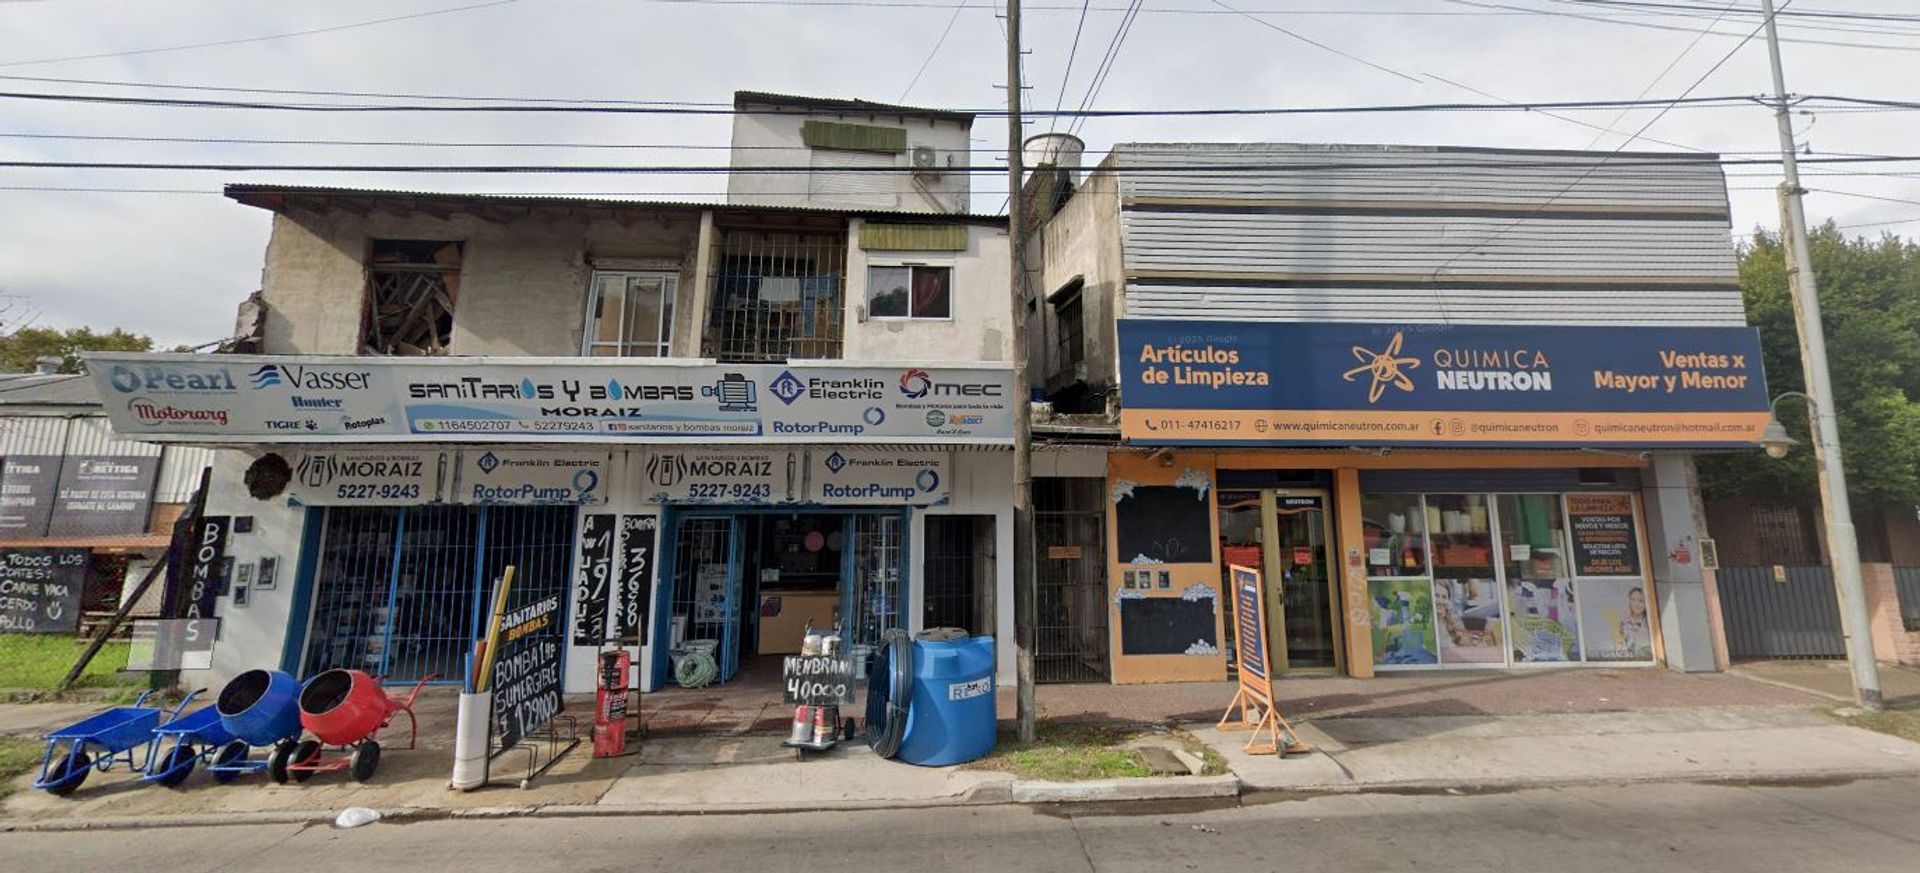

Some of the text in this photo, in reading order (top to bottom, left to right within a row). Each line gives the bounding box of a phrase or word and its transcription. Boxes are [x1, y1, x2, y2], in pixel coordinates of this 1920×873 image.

[1140, 344, 1239, 364] Artículos
[1434, 350, 1549, 370] QUIMICA
[1660, 350, 1744, 368] Ventas x
[145, 366, 237, 390] Pearl
[281, 365, 371, 391] Vasser
[809, 378, 884, 389] Franklin
[1141, 367, 1269, 390] de Limpieza
[1437, 371, 1551, 390] NEUTRON
[1594, 371, 1747, 393] Mayor y Menor
[809, 389, 884, 400] Electric
[134, 404, 229, 426] Motorarg
[541, 407, 642, 418] MORAIZ
[265, 420, 300, 430] TIGRE
[345, 417, 386, 431] Rotoplas
[438, 421, 511, 431] 1164502707
[534, 421, 594, 431] 52279243
[684, 423, 720, 432] bombas
[774, 421, 864, 436] RotorPump
[1188, 420, 1241, 430] 47416217
[1273, 420, 1419, 432] www.quimicaneutron.com.ar
[340, 462, 423, 477] MORAIZ
[502, 458, 600, 467] Franklin Electric
[690, 462, 772, 477] MORAIZ
[849, 458, 940, 467] Franklin Electric
[337, 484, 420, 499] 5227-9243
[473, 484, 571, 500] RotorPump
[689, 483, 771, 498] 5227-9243
[823, 483, 916, 500] RotorPump
[7, 553, 83, 567] TODOS LOS
[508, 614, 550, 641] BOMBAS
[495, 647, 539, 689] BOMBA
[495, 662, 558, 712] SUMERGIBLE
[788, 678, 847, 701] 40000
